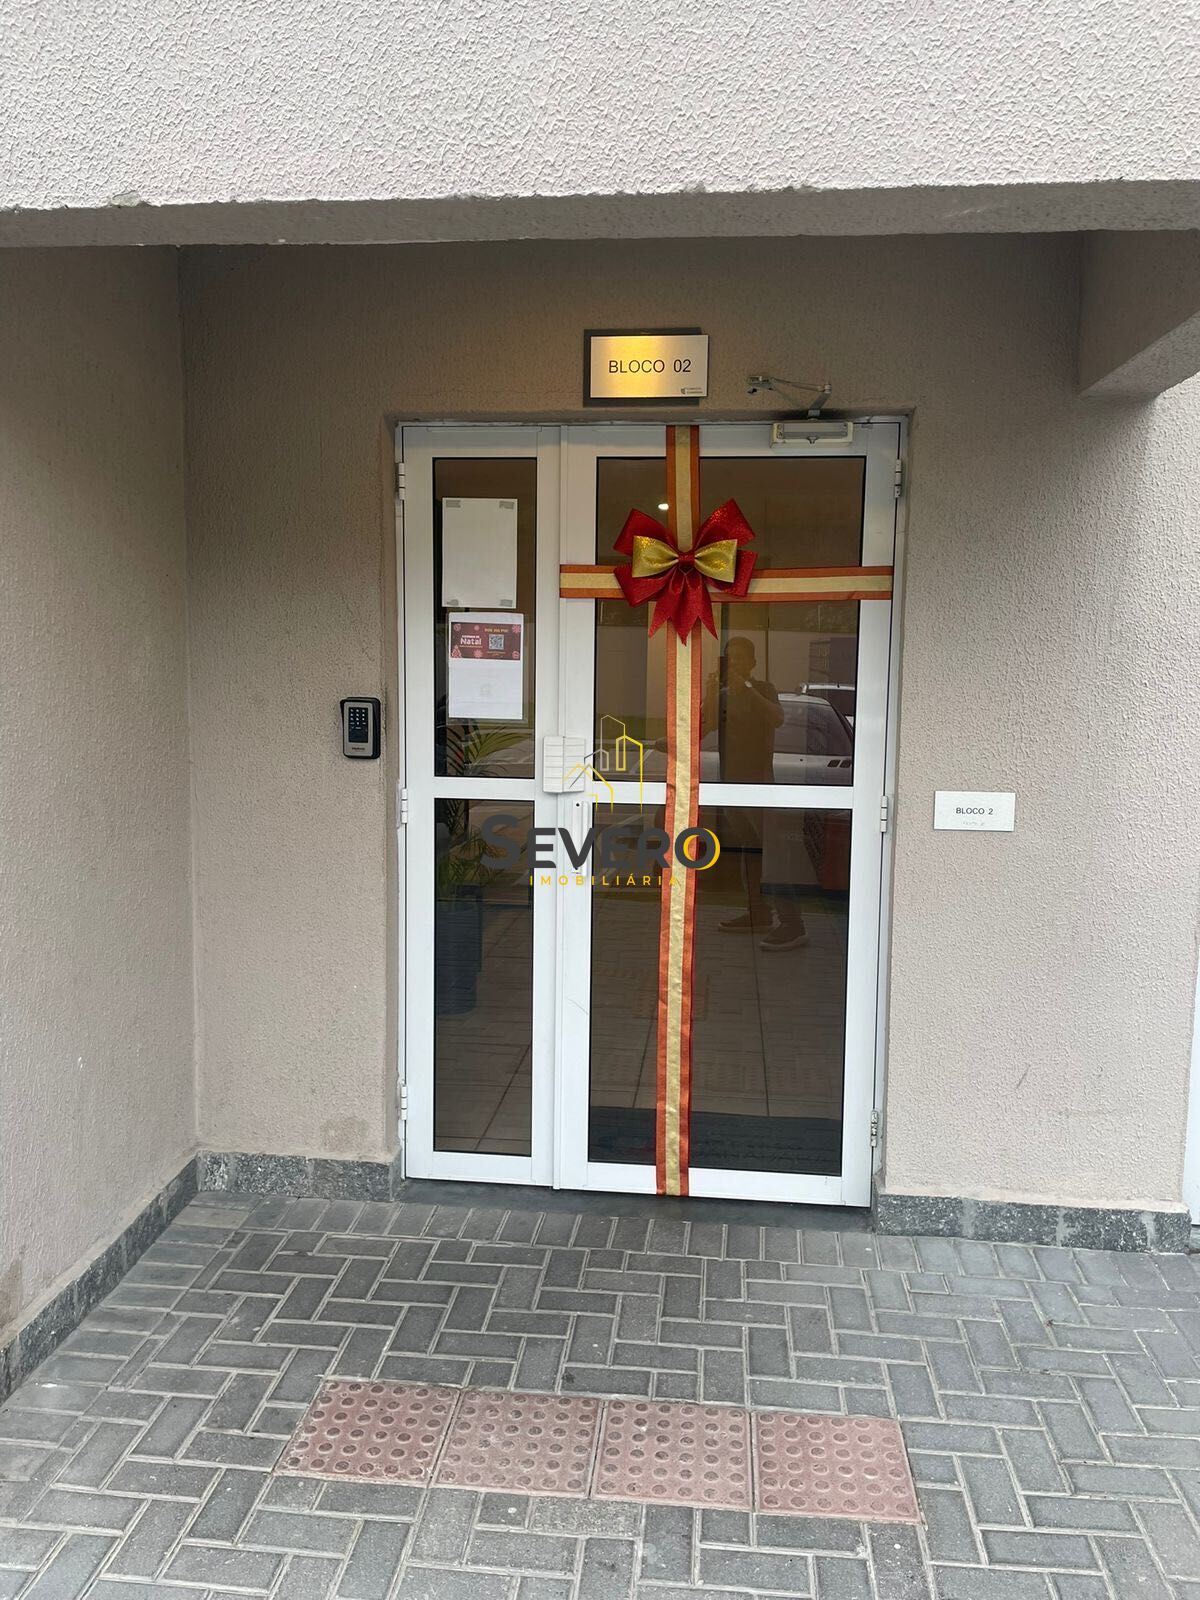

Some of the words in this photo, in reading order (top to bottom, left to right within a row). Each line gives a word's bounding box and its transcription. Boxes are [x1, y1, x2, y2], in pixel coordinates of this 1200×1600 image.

[608, 359, 665, 373] BLOCO
[673, 359, 692, 373] 02
[460, 637, 482, 645] Natal
[955, 807, 985, 815] BLOCO
[988, 807, 994, 815] 2
